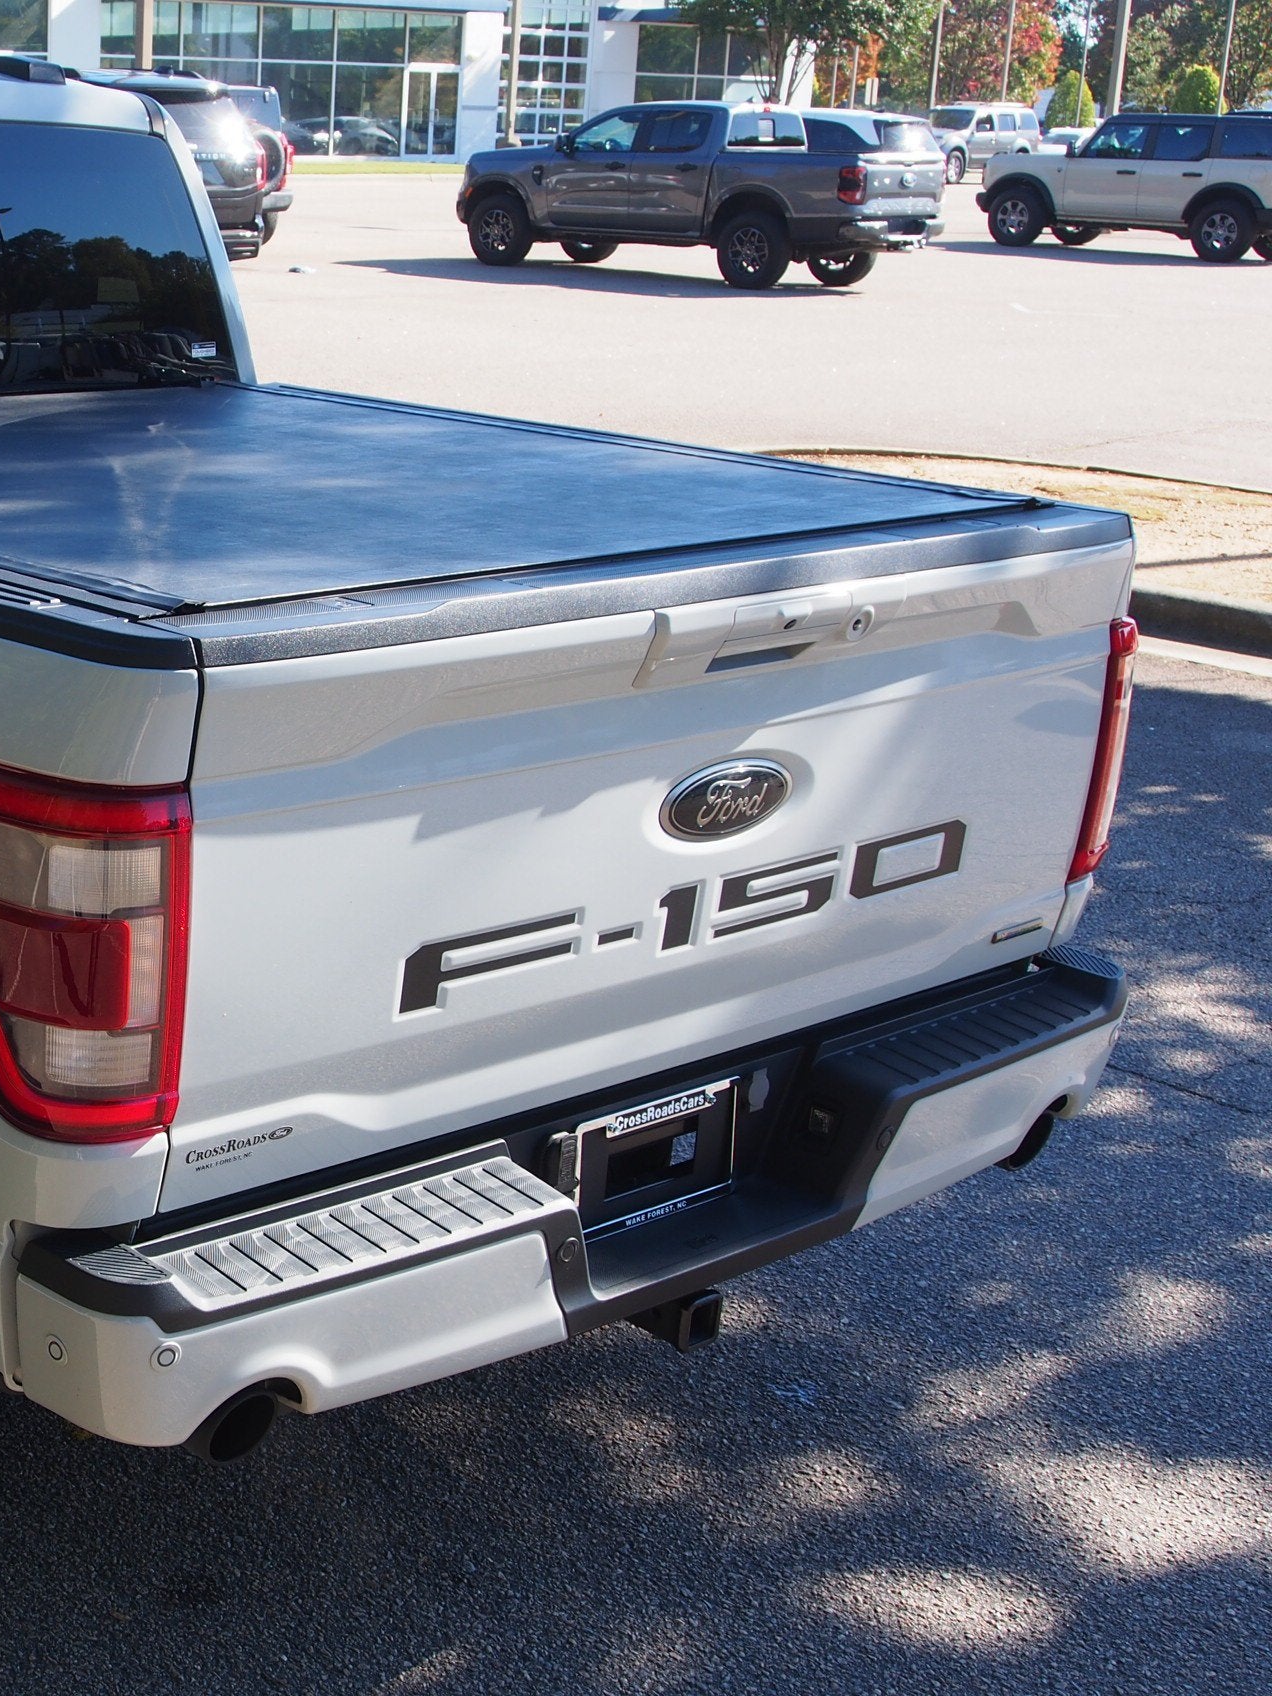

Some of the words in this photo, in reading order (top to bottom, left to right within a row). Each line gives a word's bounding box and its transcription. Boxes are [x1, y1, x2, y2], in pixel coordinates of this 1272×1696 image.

[696, 776, 769, 828] Ford
[396, 818, 968, 1017] F-150
[615, 1093, 706, 1132] CrossRoadsCars
[195, 1162, 214, 1172] WAKE
[625, 1214, 646, 1227] WAKE
[647, 1204, 676, 1220] FOREST,
[677, 1200, 688, 1209] NC
